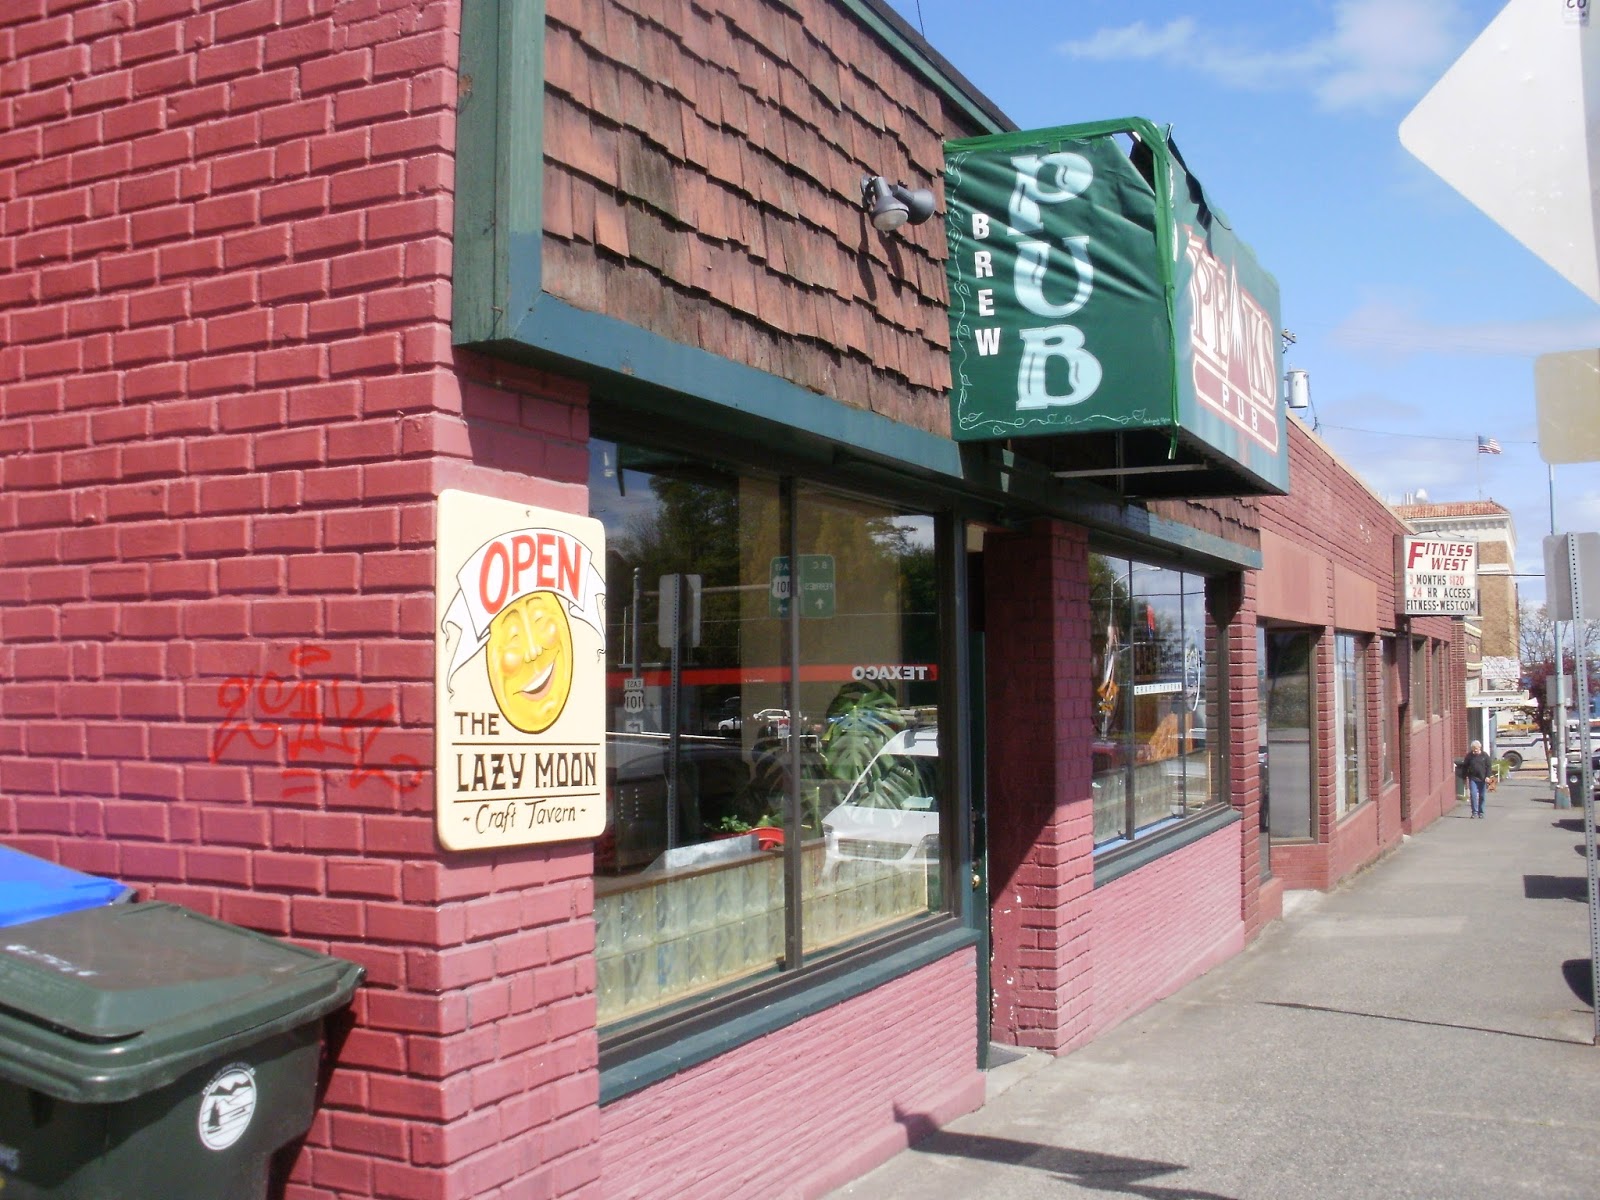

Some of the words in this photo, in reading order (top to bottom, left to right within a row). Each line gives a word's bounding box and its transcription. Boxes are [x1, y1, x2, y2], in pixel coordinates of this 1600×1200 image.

[971, 213, 1001, 356] BREW
[1007, 152, 1103, 411] PUB
[1221, 382, 1258, 432] PUB
[1407, 541, 1474, 569] FITNESS
[1431, 557, 1469, 571] WEST
[479, 533, 583, 615] OPEN
[1412, 586, 1423, 598] 24
[1427, 587, 1438, 598] HR
[1444, 588, 1471, 599] ACCESS
[1416, 574, 1447, 586] MONTHS
[454, 711, 500, 736] THE
[456, 752, 526, 793] LAZY
[535, 752, 598, 788] MOON
[475, 802, 517, 835] Craft
[525, 798, 576, 830] Tavern
